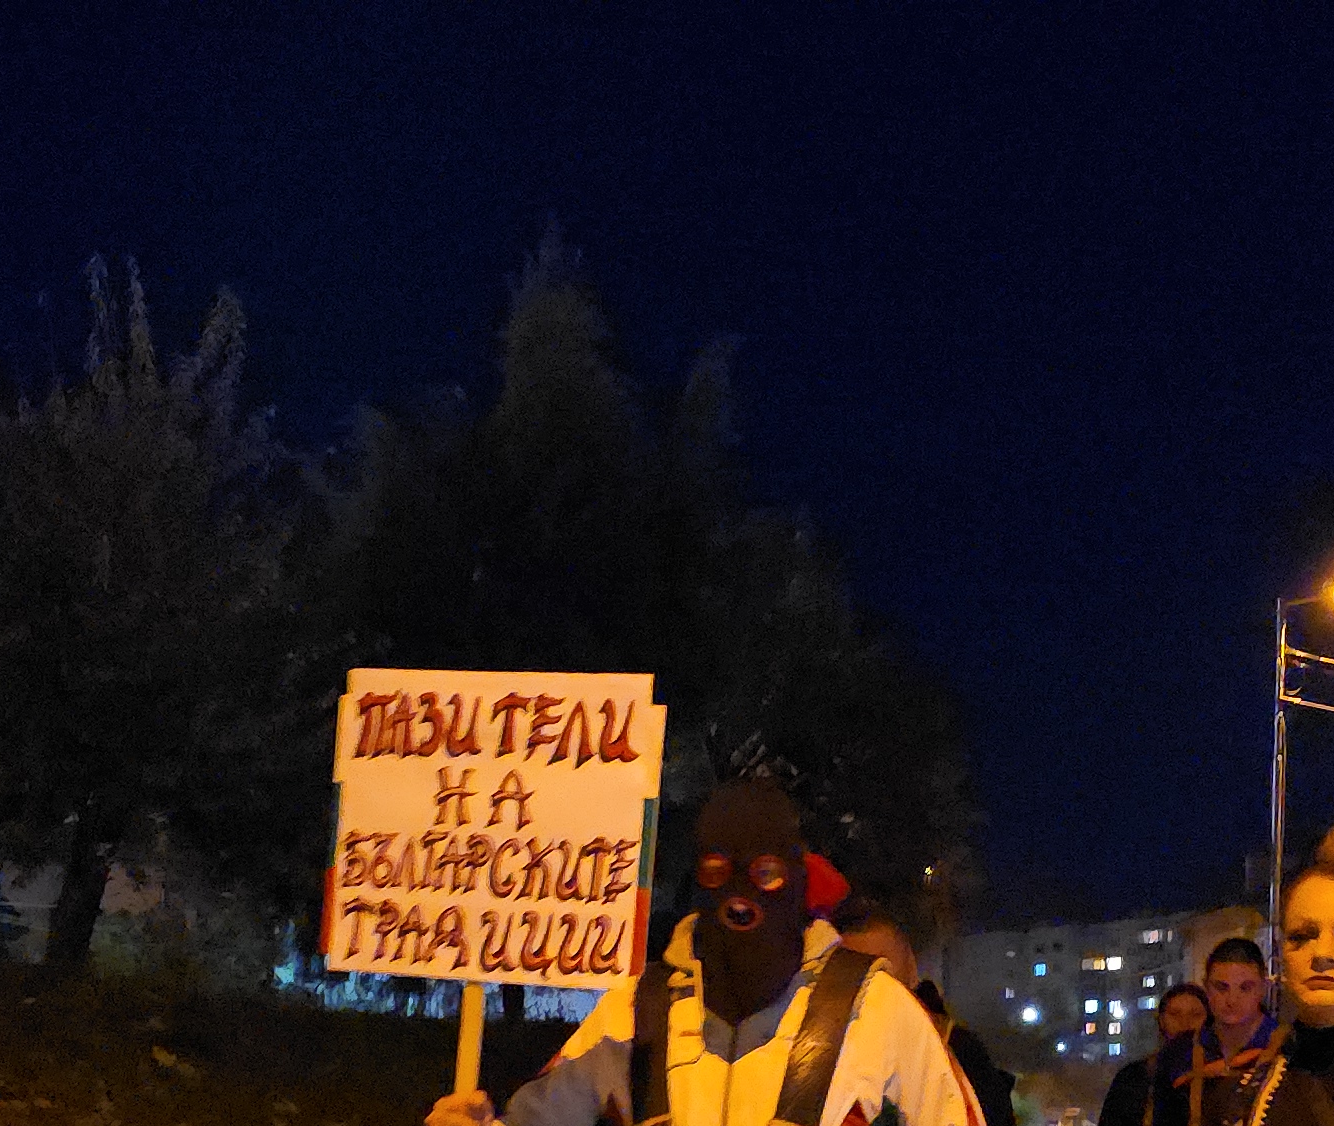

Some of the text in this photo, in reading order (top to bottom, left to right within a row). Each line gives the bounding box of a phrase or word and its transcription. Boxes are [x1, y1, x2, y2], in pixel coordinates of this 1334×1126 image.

[351, 689, 641, 769] ПАЗИТЕЛИ
[433, 765, 536, 831] НА
[341, 829, 640, 905] БЪЛГАРСКИТЕ
[341, 896, 627, 980] ТРАДИЦИИ
